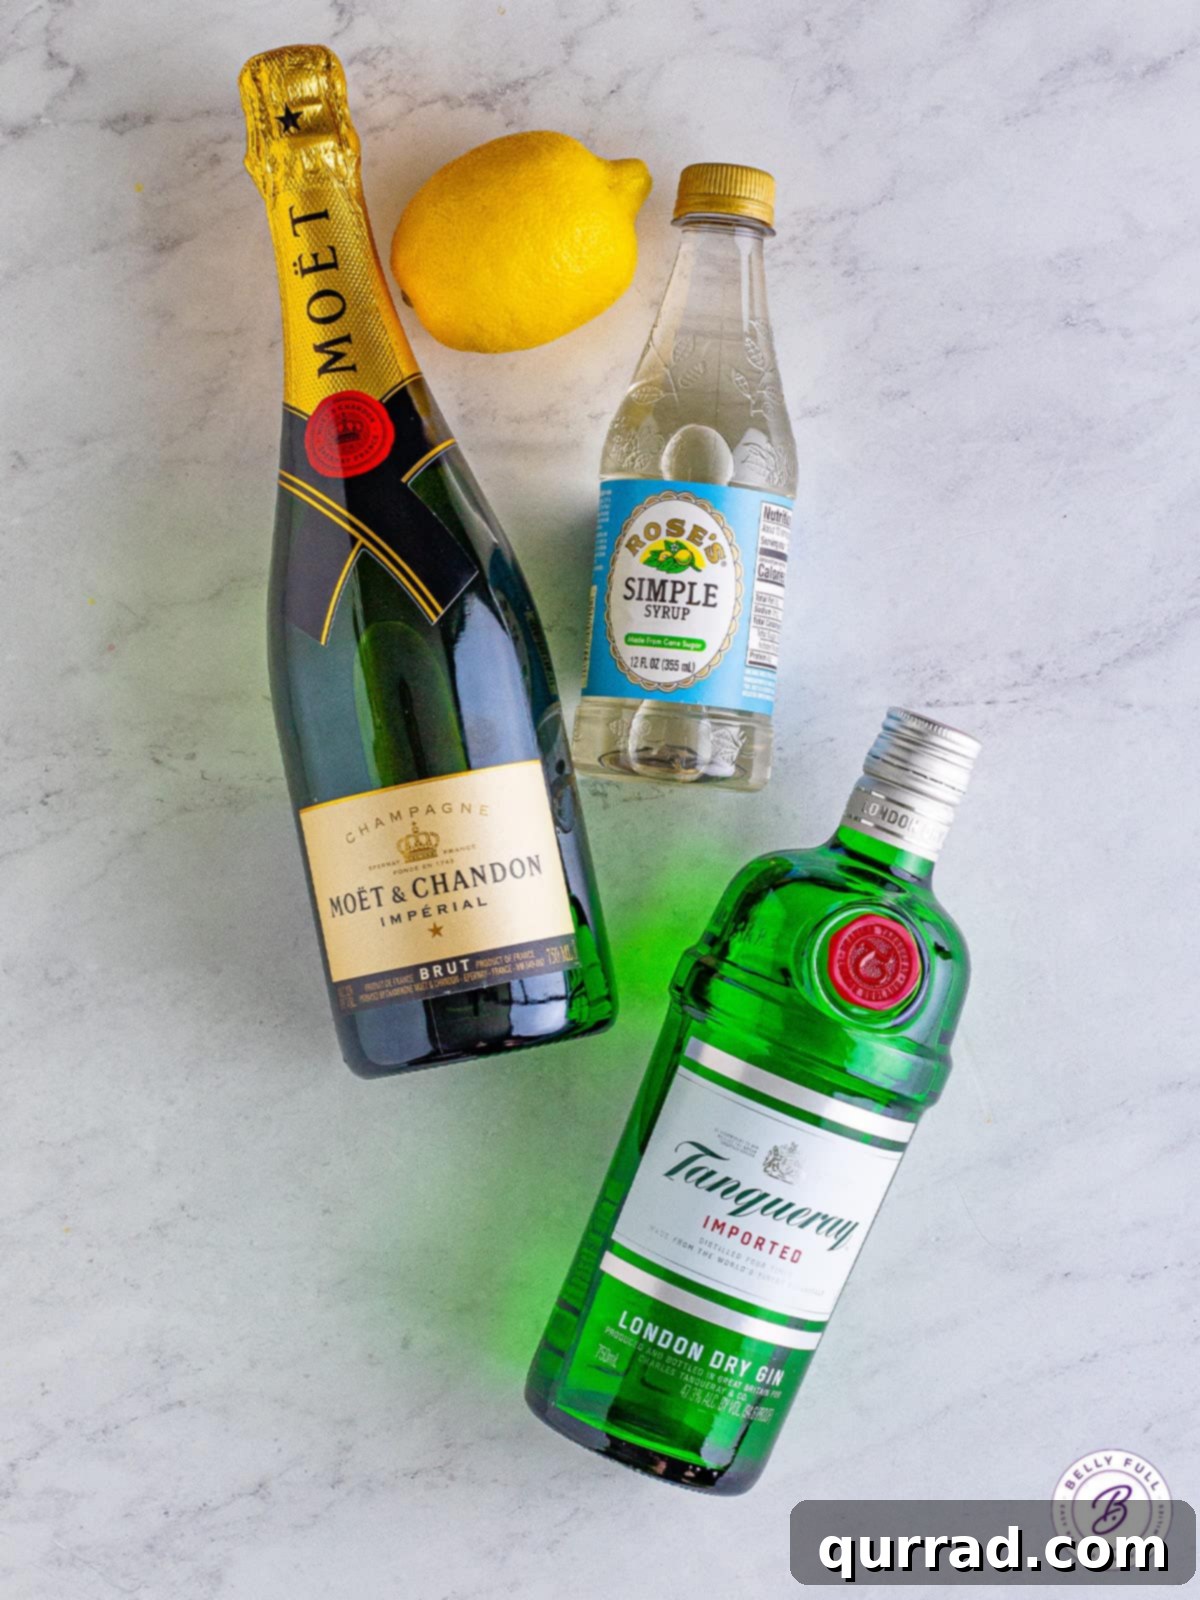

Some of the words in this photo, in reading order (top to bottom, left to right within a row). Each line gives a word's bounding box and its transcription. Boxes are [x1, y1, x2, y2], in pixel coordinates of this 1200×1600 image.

[289, 205, 357, 377] MOËT
[625, 518, 726, 564] ROSE'S
[623, 577, 718, 608] SIMPLE
[644, 604, 690, 620] SYRUP
[650, 658, 660, 669] OZ
[682, 640, 702, 650] Sugar
[345, 802, 489, 844] CHAMPAGNE
[329, 886, 384, 918] MOËT
[392, 886, 407, 904] &
[412, 854, 543, 899] CHANDON
[380, 897, 488, 927] IMPÉRIAL
[419, 958, 470, 980] BRUT
[663, 1141, 859, 1252] Tanqueray
[702, 1215, 802, 1264] IMPORTED
[618, 1310, 704, 1362] LONDON
[709, 1350, 752, 1378] DRY
[755, 1365, 785, 1387] GIN
